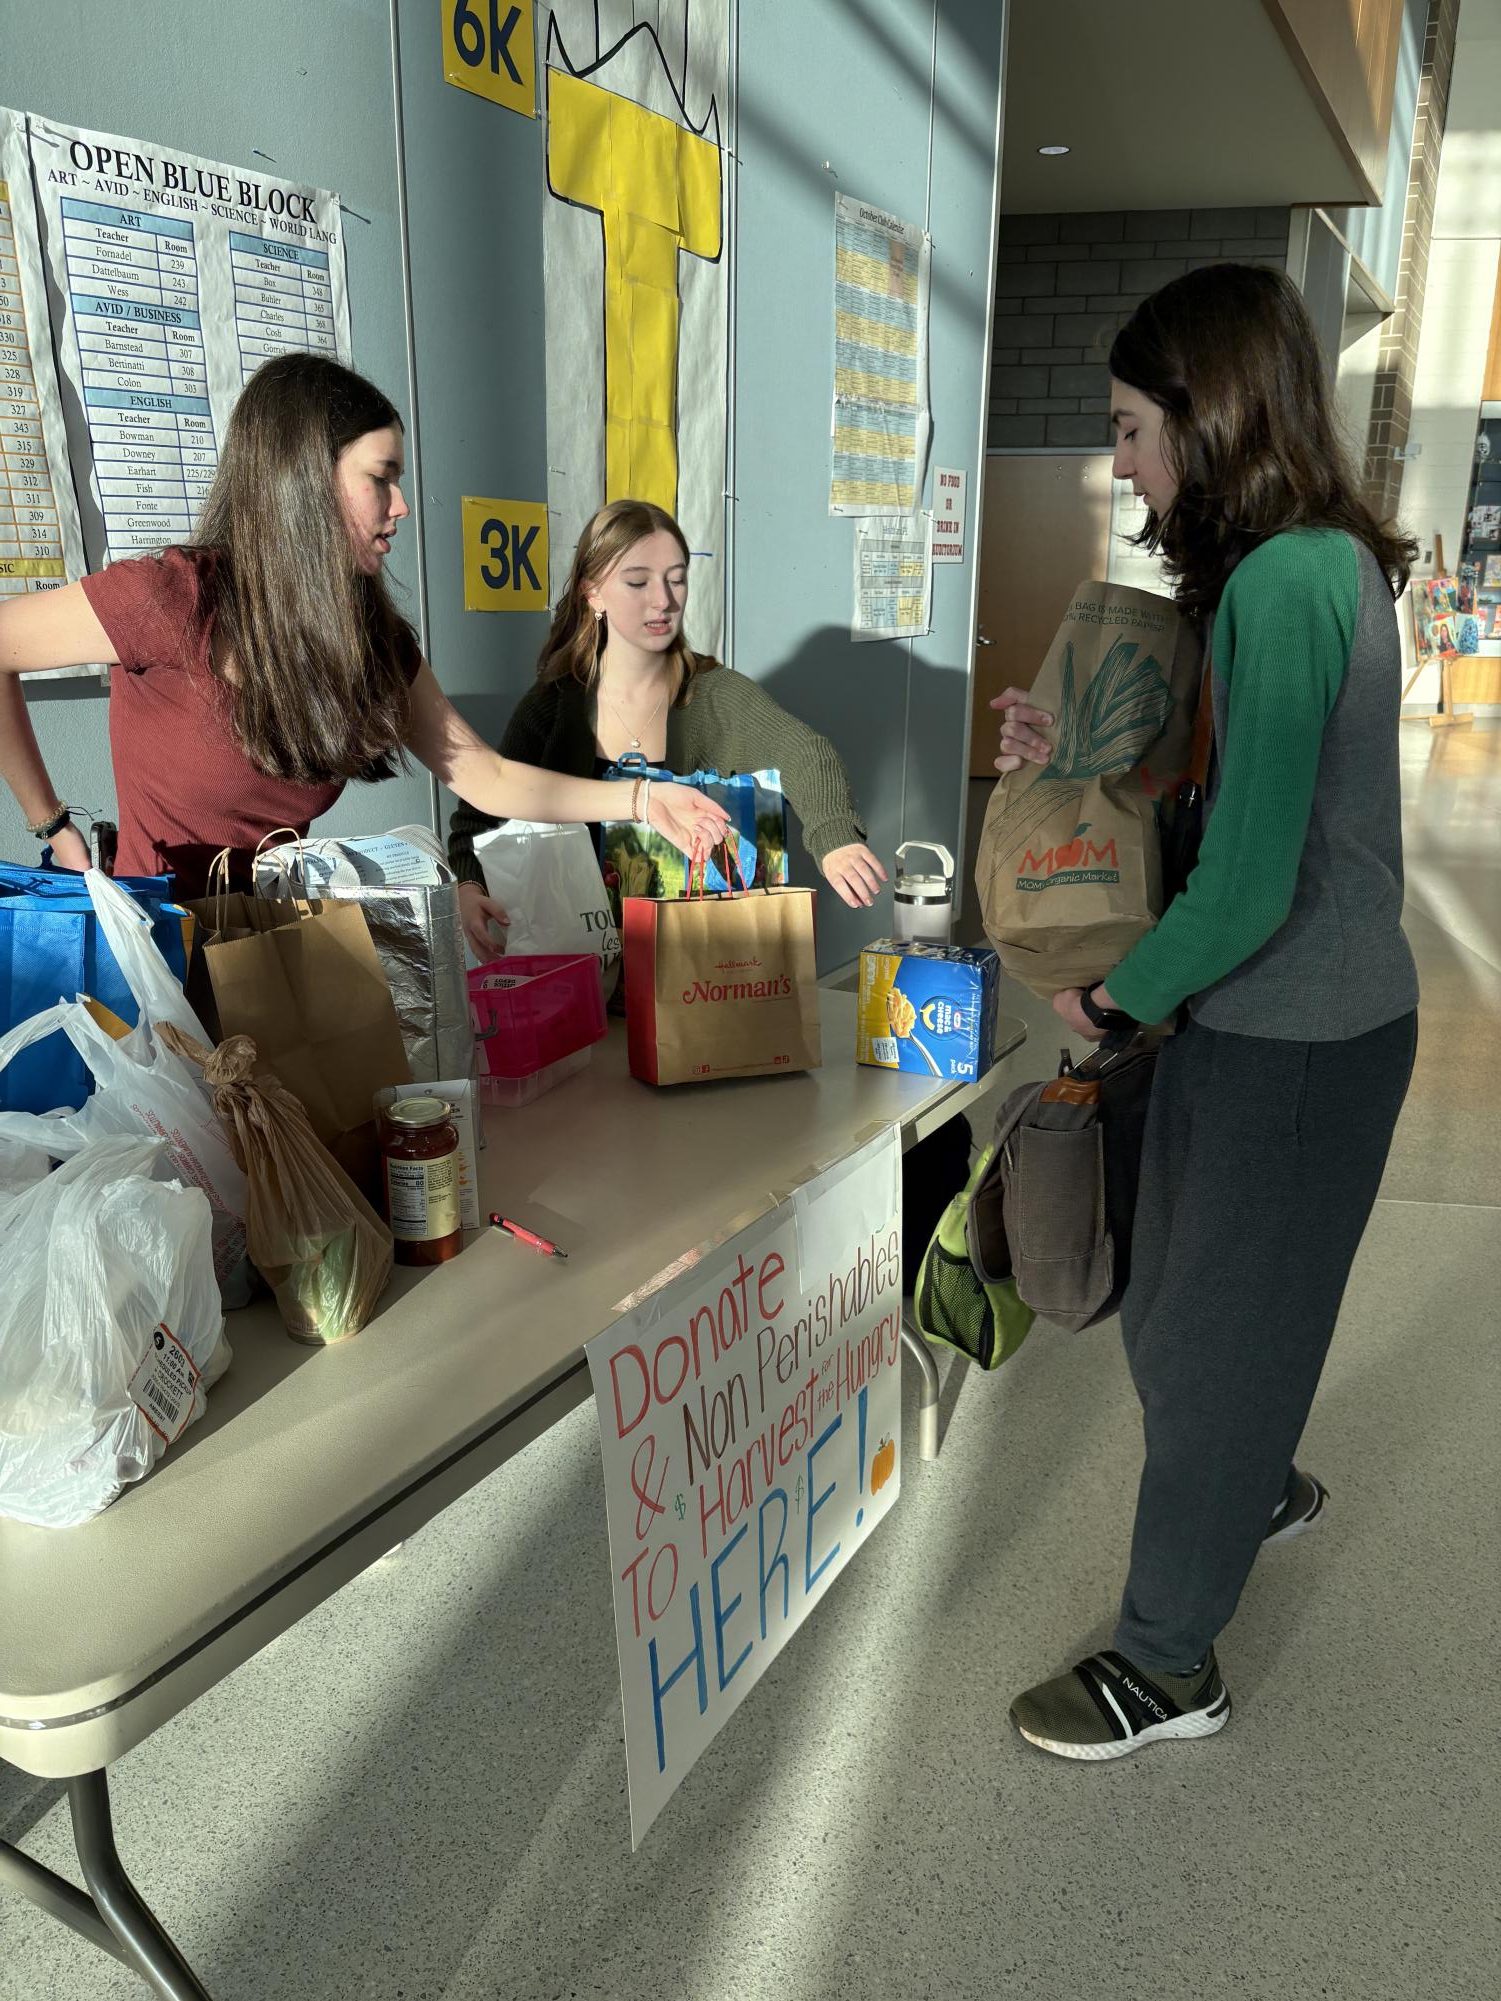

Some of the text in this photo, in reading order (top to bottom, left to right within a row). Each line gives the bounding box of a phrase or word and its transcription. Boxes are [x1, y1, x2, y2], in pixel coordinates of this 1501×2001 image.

[453, 0, 524, 87] 6K
[70, 141, 317, 224] OPEN BLUE BLOCK
[48, 168, 78, 186] ART
[95, 178, 128, 196] AVID
[144, 188, 198, 212] ENGLISH
[212, 204, 258, 226] SCIENCE
[270, 218, 306, 236] WORLD
[309, 228, 337, 244] LANG
[120, 214, 142, 227] ART
[96, 228, 129, 243] Teacher
[165, 241, 188, 253] Room
[263, 244, 299, 260] SCIENCE
[96, 247, 132, 261] Fornadel
[171, 260, 184, 270] 239
[255, 259, 281, 272] Teacher
[92, 264, 139, 280] Dattelbaum
[308, 270, 324, 282] Room
[172, 278, 186, 288] 243
[107, 285, 129, 297] Wess
[174, 296, 187, 306] 242
[96, 302, 123, 314] AVID
[134, 308, 182, 323] BUSINESS
[260, 310, 284, 322] Charles
[106, 322, 138, 334] Teacher
[0, 332, 14, 343] 330
[172, 331, 195, 342] Room
[106, 339, 144, 353] Barnstead
[2, 350, 18, 361] 325
[180, 349, 192, 358] 307
[109, 358, 144, 371] Bertinatti
[5, 368, 20, 379] 328
[118, 376, 142, 388] Colon
[8, 387, 23, 397] 319
[130, 396, 172, 408] ENGLISH
[11, 405, 26, 415] 327
[118, 412, 150, 424] Teacher
[184, 418, 206, 428] Room
[14, 422, 29, 433] 343
[120, 430, 154, 442] Bowman
[191, 436, 204, 444] 210
[17, 440, 32, 451] 315
[123, 448, 156, 460] Downey
[193, 452, 206, 462] 207
[20, 458, 35, 468] 329
[128, 466, 156, 476] Earhart
[23, 476, 38, 486] 312
[940, 474, 960, 489] NO FOOD
[136, 484, 152, 493] Fish
[26, 494, 41, 504] 311
[946, 498, 952, 511] OR
[29, 512, 44, 522] 309
[128, 518, 171, 528] Greenwood
[32, 529, 47, 539] 314
[132, 536, 172, 546] Harrington
[35, 546, 50, 556] 310
[481, 518, 542, 591] 3K
[35, 580, 60, 590] Room
[1076, 602, 1096, 612] BAG
[1109, 606, 1138, 616] MADE
[1079, 613, 1128, 625] RECYCLED
[602, 931, 620, 951] les
[682, 974, 792, 1004] Norman's
[957, 1062, 974, 1075] 5
[609, 1252, 785, 1439] Donate
[631, 1231, 900, 1541] & Non Perishables
[622, 1542, 678, 1638] TO
[699, 1368, 818, 1559] Harvest
[816, 1380, 834, 1412] the
[836, 1306, 900, 1412] Hungry
[674, 1492, 686, 1521] $
[1122, 1677, 1168, 1721] NAUTICA
